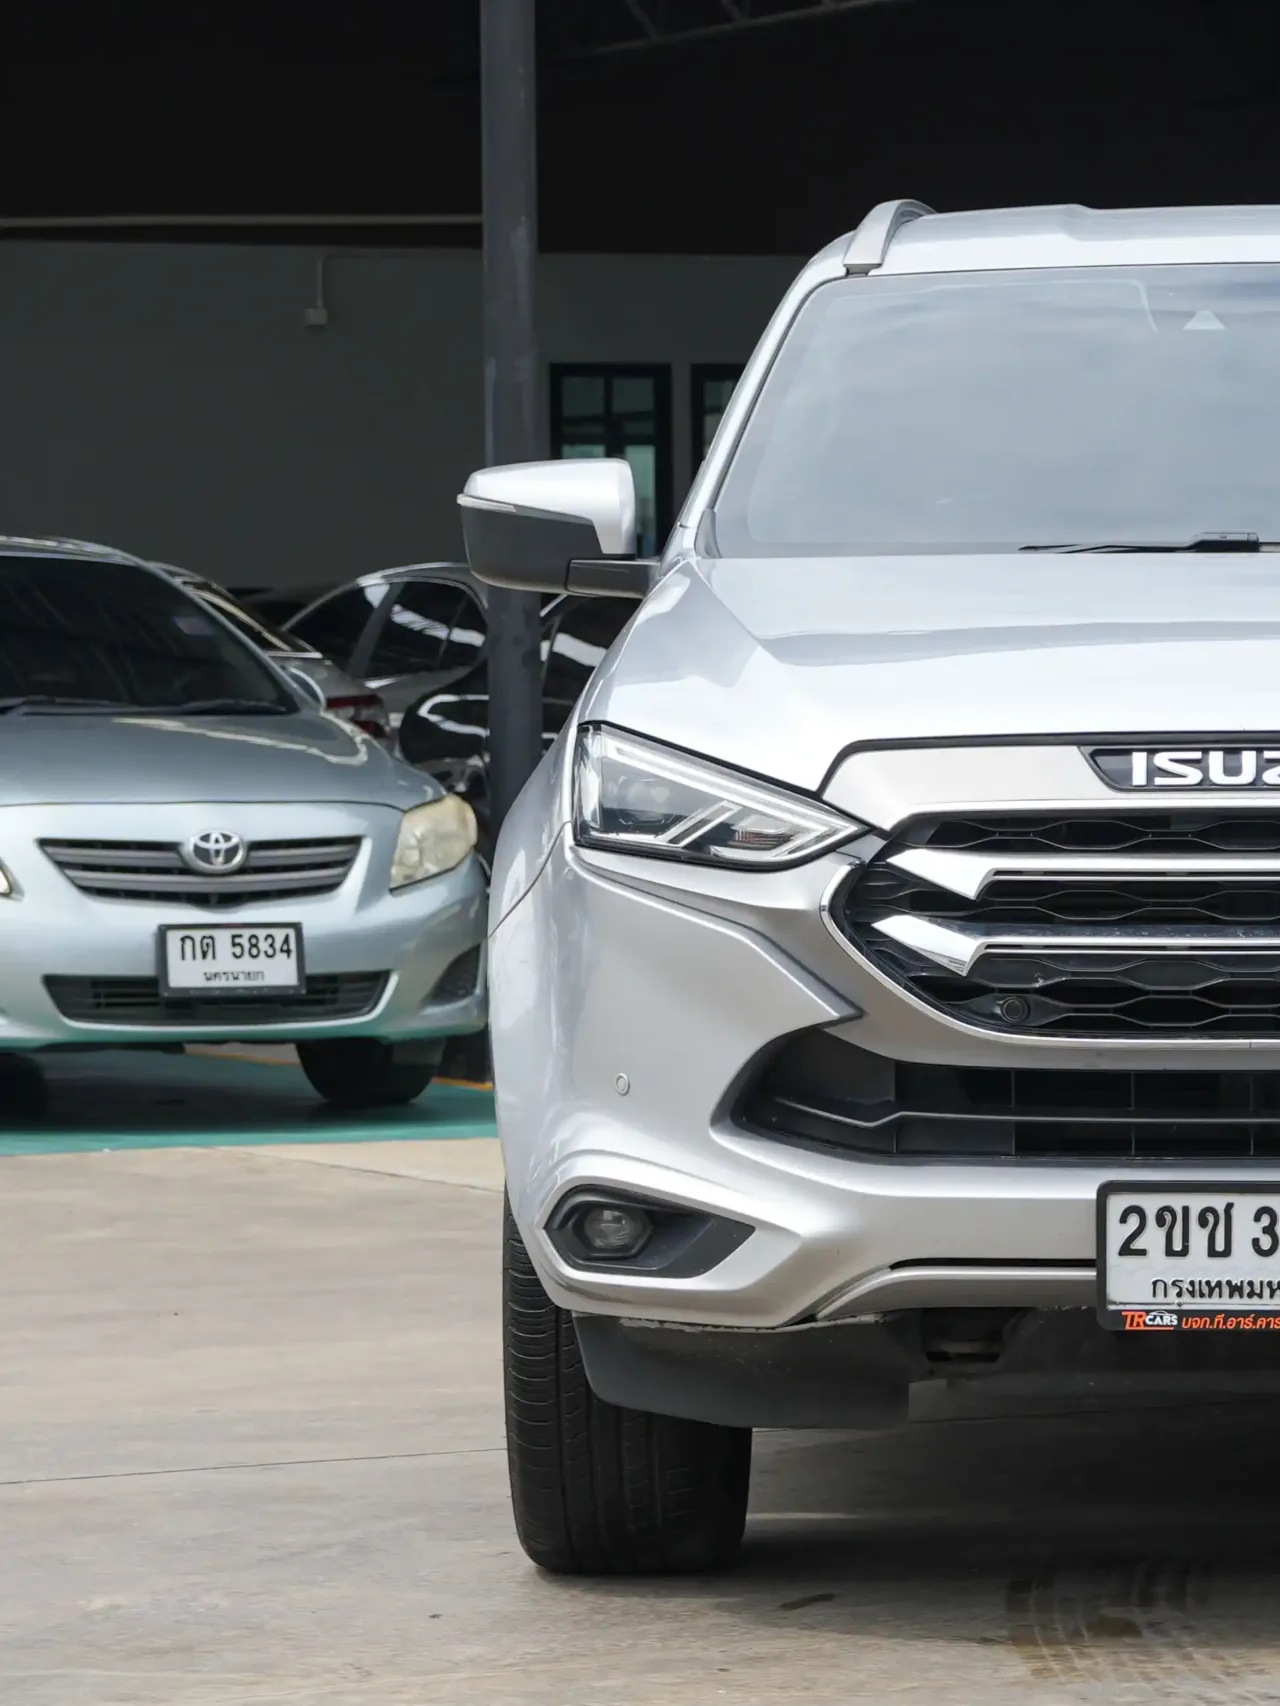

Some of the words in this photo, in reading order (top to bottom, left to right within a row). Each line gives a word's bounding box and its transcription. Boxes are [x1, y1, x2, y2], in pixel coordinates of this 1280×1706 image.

[231, 933, 292, 959] 5834
[1117, 1202, 1235, 1258] 2ขช
[1145, 1314, 1178, 1326] CARS
